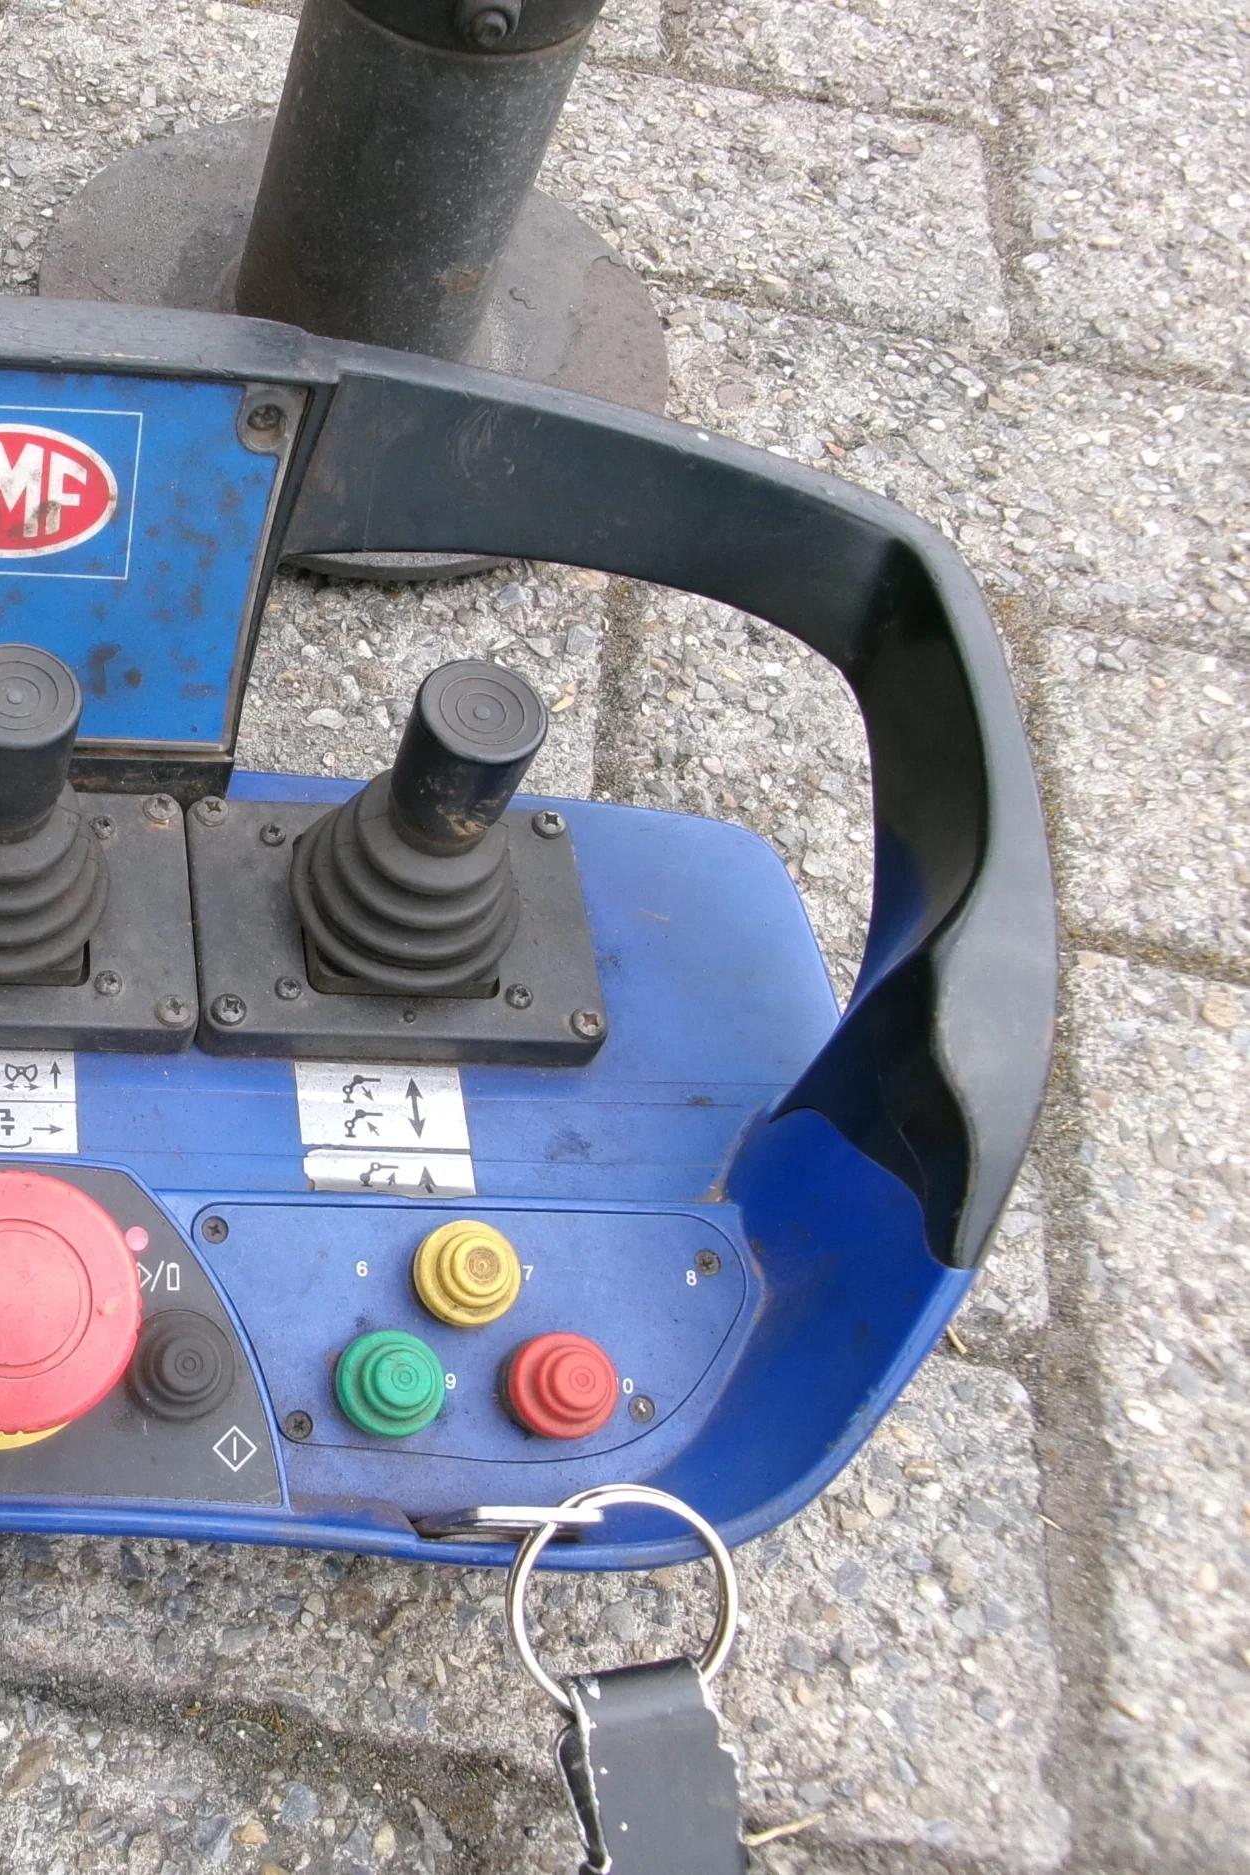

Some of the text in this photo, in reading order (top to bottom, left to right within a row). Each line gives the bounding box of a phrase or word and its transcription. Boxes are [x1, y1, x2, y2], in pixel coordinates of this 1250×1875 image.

[356, 1261, 368, 1277] 6
[522, 1266, 534, 1281] 7
[685, 1270, 697, 1286] 8
[444, 1373, 456, 1390] 9
